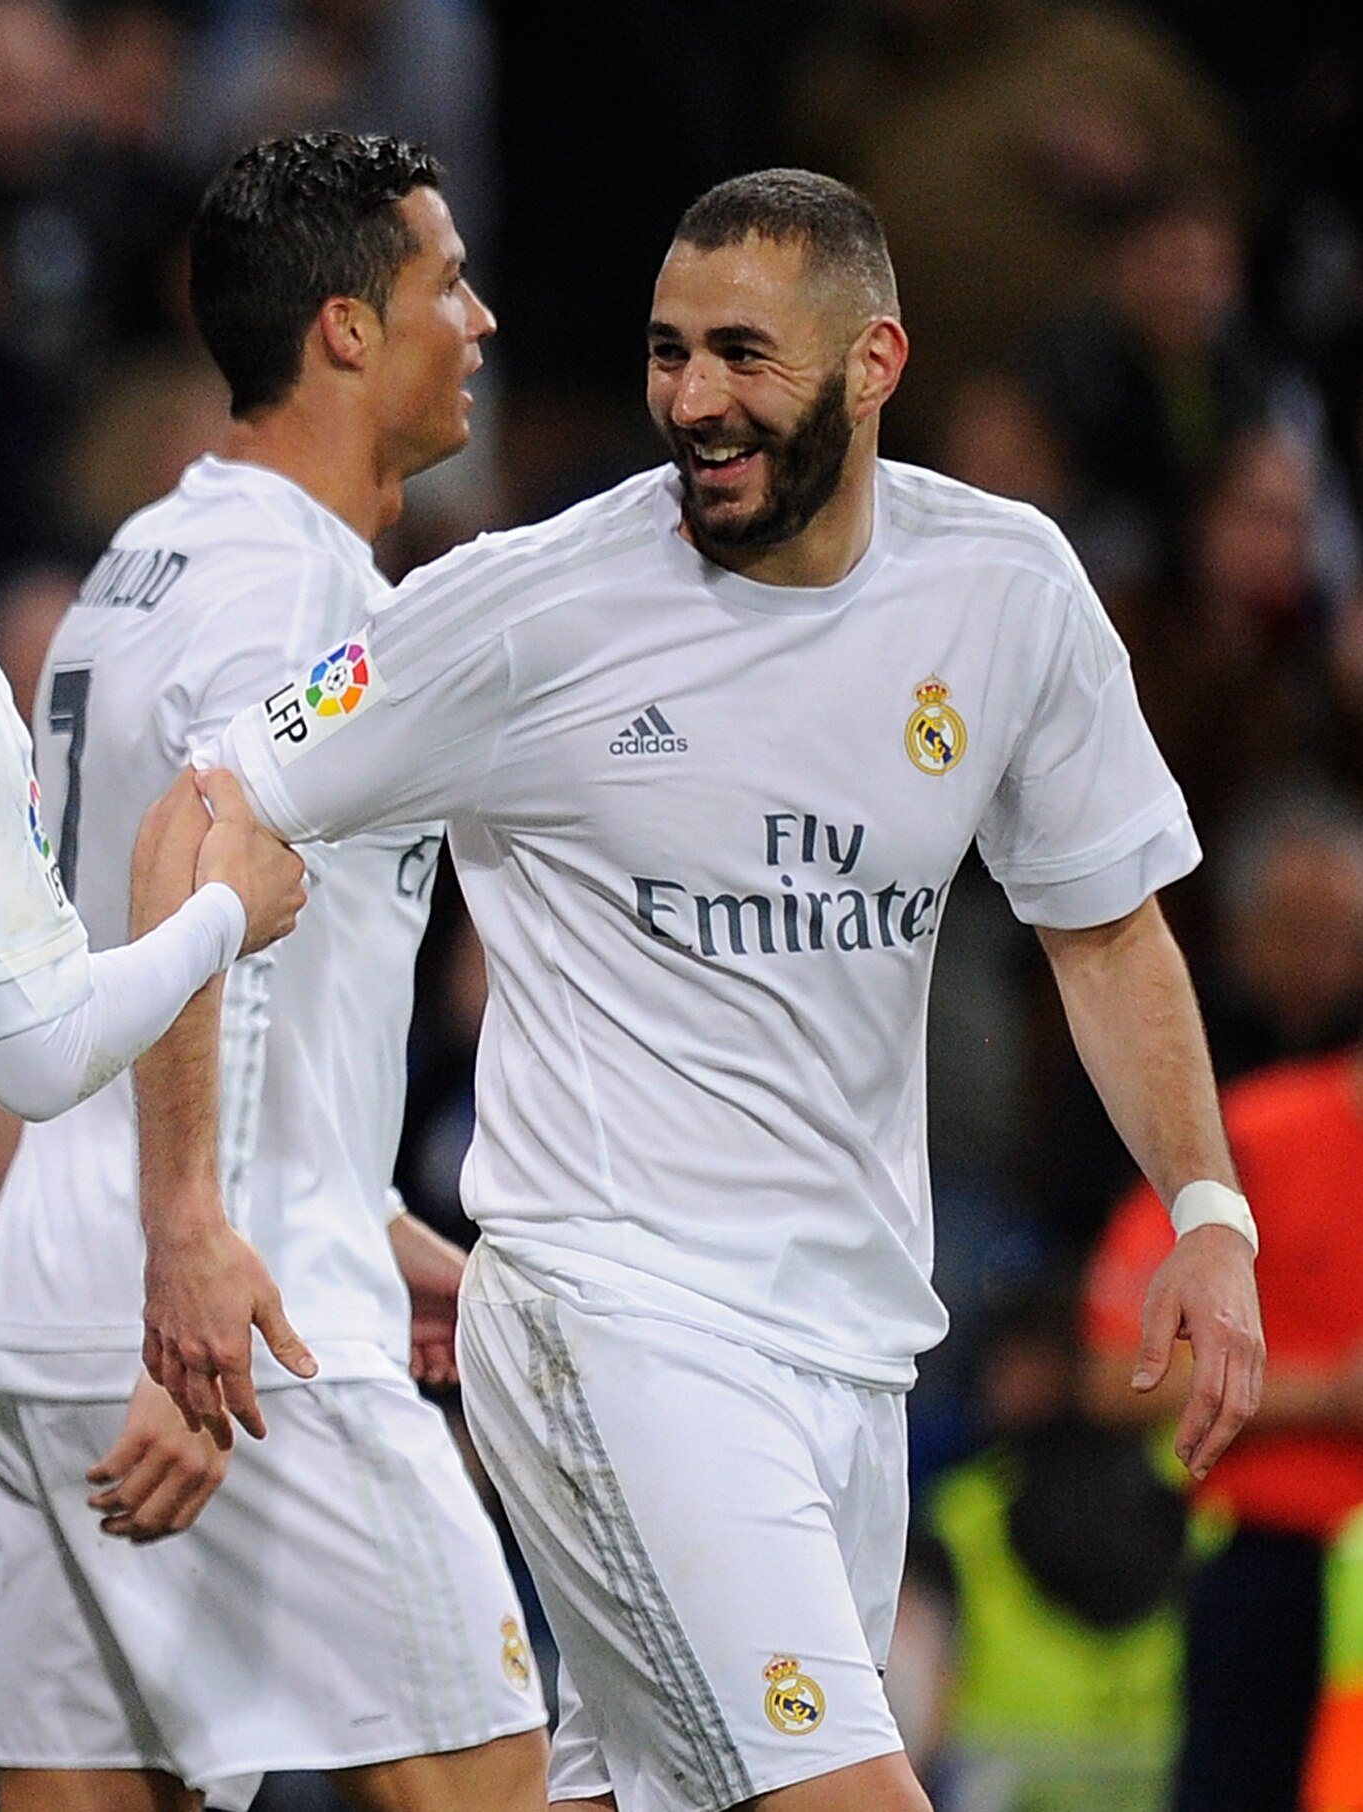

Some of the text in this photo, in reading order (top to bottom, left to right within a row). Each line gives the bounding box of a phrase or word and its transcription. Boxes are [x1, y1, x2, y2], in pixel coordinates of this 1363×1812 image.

[265, 682, 308, 743] LFP
[609, 735, 688, 756] adidas
[763, 814, 865, 875] Fly
[632, 874, 949, 957] Emirate
